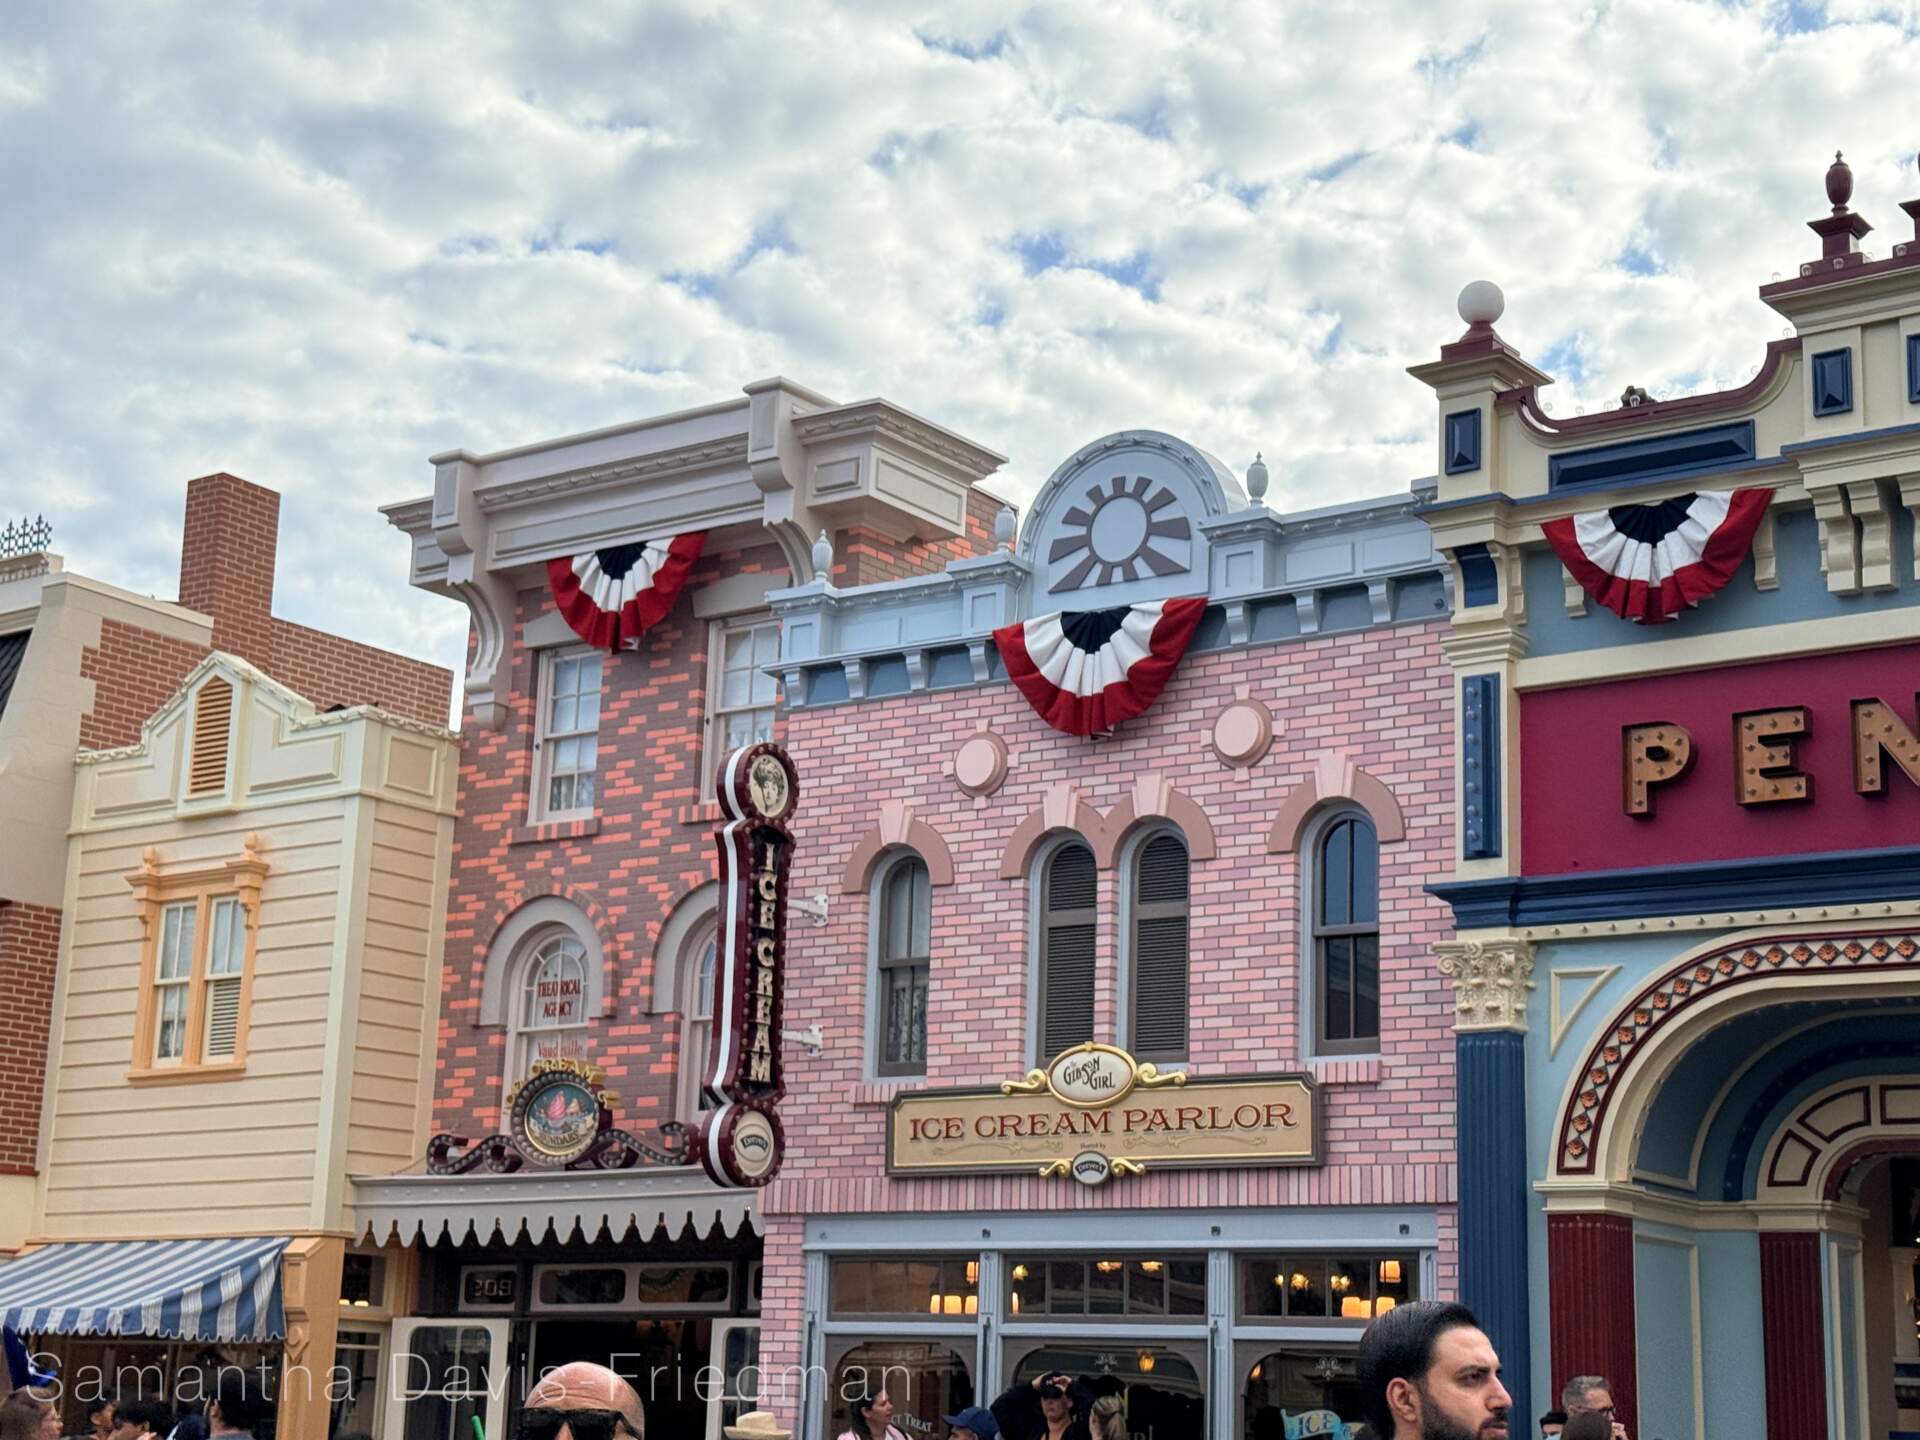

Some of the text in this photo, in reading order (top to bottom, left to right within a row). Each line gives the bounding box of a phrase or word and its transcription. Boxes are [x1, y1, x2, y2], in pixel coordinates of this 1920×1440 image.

[1622, 692, 1920, 817] PEN
[750, 843, 778, 1082] ICE CREAM
[543, 1001, 574, 1019] AGENCY
[537, 1040, 583, 1057] Vaudville
[1089, 1070, 1116, 1090] GIRL
[909, 1103, 1298, 1141] ICE CREAM PARLOR
[904, 1412, 933, 1433] TREAT
[1298, 1413, 1334, 1437] ICE
